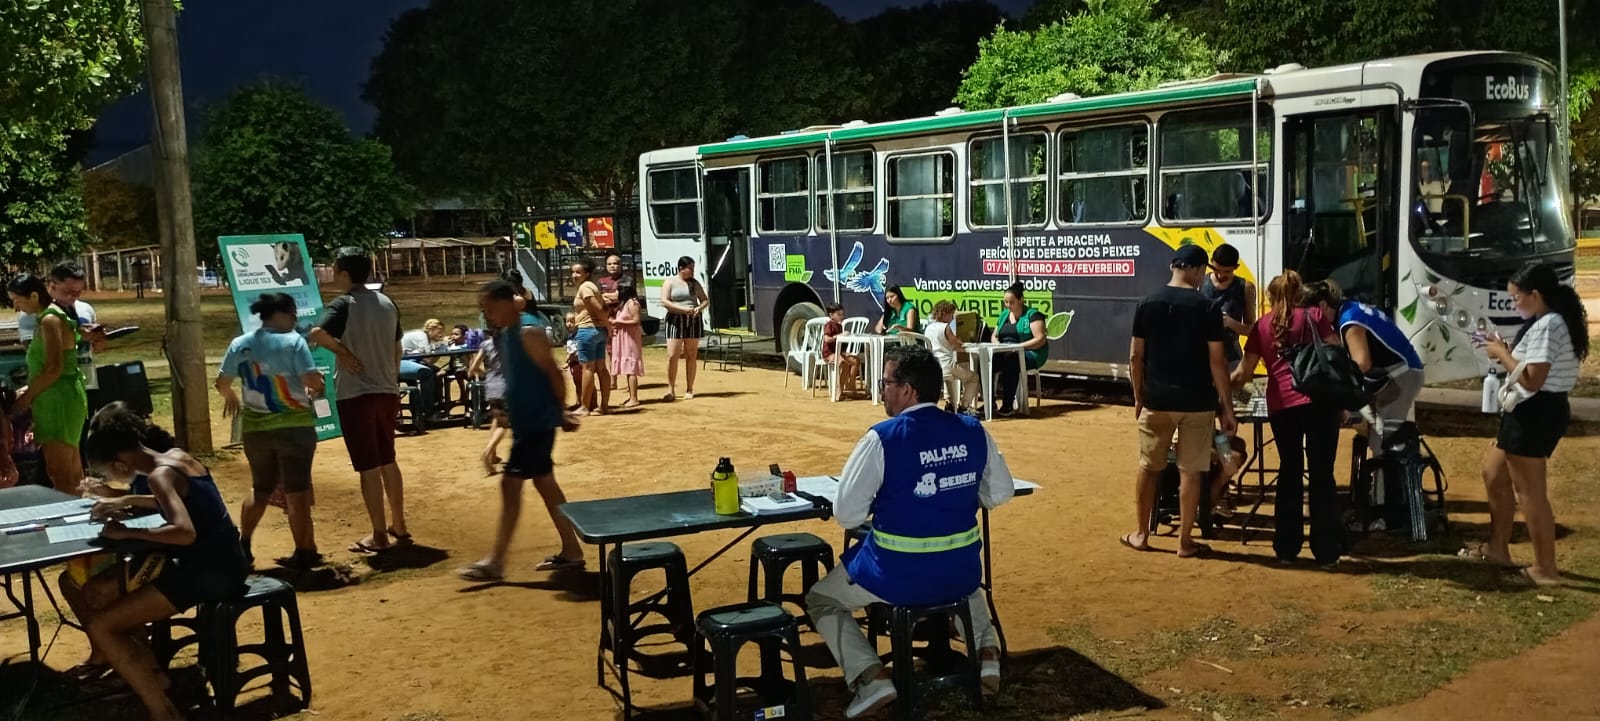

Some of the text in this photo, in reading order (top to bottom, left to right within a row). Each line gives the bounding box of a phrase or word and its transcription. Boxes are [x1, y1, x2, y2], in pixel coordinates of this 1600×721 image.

[1485, 75, 1530, 100] EcoBus
[1002, 234, 1111, 247] RSPEITE A PIRACEMA
[1022, 248, 1035, 259] DE
[1037, 248, 1075, 259] DEFESO
[1078, 247, 1100, 258] DOS
[1102, 245, 1140, 257] PEIXES
[645, 261, 678, 277] EcoBu
[1053, 263, 1061, 273] A
[1062, 263, 1130, 274] 28/FEVEREIRO
[914, 277, 952, 291] Vamos
[955, 278, 1011, 291] conversa
[919, 444, 968, 465] PALMAS
[938, 471, 977, 489] SEBEM
